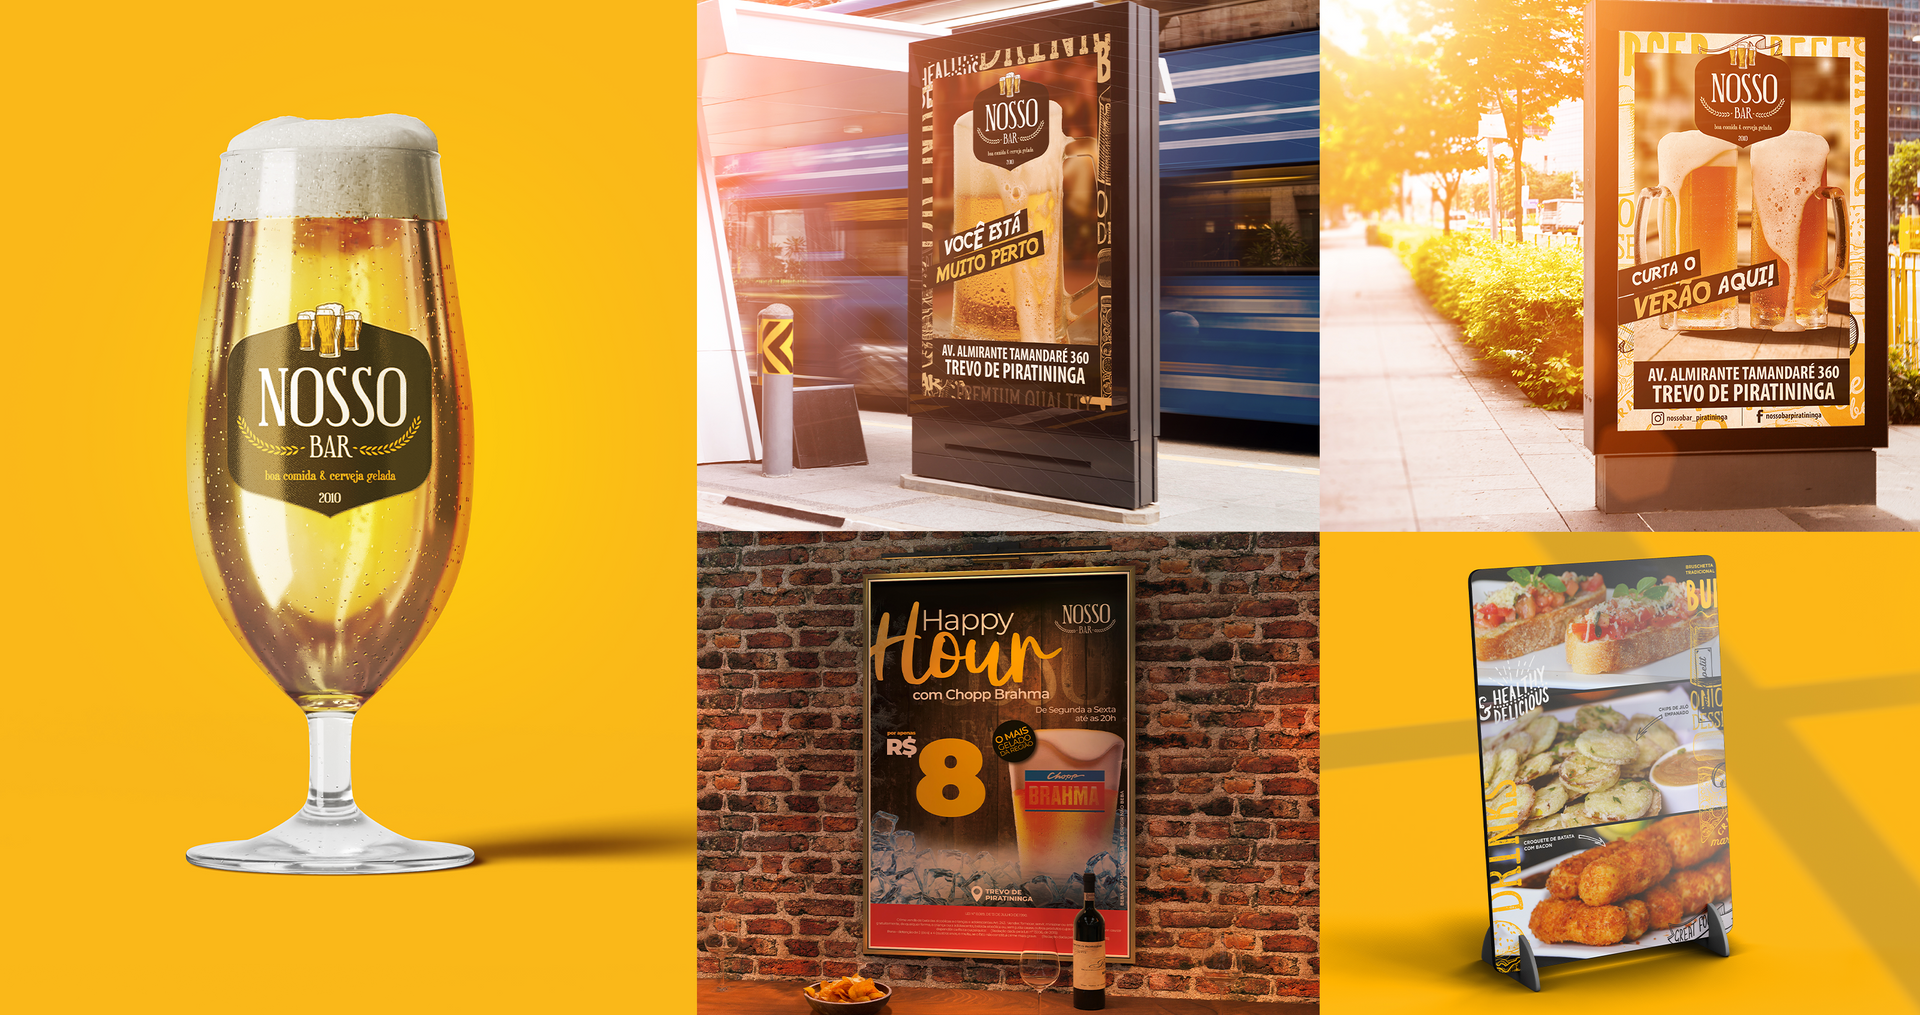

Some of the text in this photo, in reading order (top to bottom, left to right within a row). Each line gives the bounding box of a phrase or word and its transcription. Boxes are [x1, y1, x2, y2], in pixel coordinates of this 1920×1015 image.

[1710, 73, 1778, 104] NOSSO
[985, 98, 1039, 132] NOSSO
[1734, 106, 1753, 119] BAR
[1003, 132, 1018, 145] BAR
[944, 209, 1021, 256] VOCÊ ESTÁ
[935, 237, 1039, 284] MUITO PERTO
[1631, 256, 1696, 287] CURTA O
[1633, 263, 1775, 320] VERÃO AQUI!
[942, 344, 1089, 365] AV. ALMIRANTE TAMANDARÉ 360
[944, 359, 1086, 385] TREVO DE PIRATININGA
[1648, 362, 1840, 382] AV. ALMIRANTE TAMANDARÉ 360
[258, 366, 407, 428] NOSSO
[1652, 384, 1705, 403] TREVO
[1709, 383, 1729, 402] DE
[1733, 382, 1835, 402] PIRATININGA
[309, 434, 353, 458] BAR
[265, 470, 396, 483] boa comida & cerveja gelada
[318, 492, 341, 503] 2010
[923, 609, 1015, 636] Happy
[1062, 603, 1111, 625] NOSSO
[1078, 625, 1093, 634] BAR
[870, 601, 1062, 687] Hour
[912, 688, 1050, 703] com Chopp Brahma
[1492, 665, 1545, 706] HEALTHY
[1035, 706, 1047, 714] De
[1048, 705, 1086, 715] Segunda
[1093, 705, 1117, 713] Sexta
[1493, 686, 1550, 725] DELICIOUS
[1075, 714, 1089, 722] até
[1100, 714, 1117, 722] 20h
[995, 735, 1004, 744] O
[1004, 726, 1029, 741] MAIS
[998, 734, 1032, 751] GELADO
[886, 735, 986, 818] R$ 8
[1047, 771, 1085, 780] Chopp
[1028, 785, 1100, 806] BRAHMA
[1484, 778, 1524, 913] DRINKS
